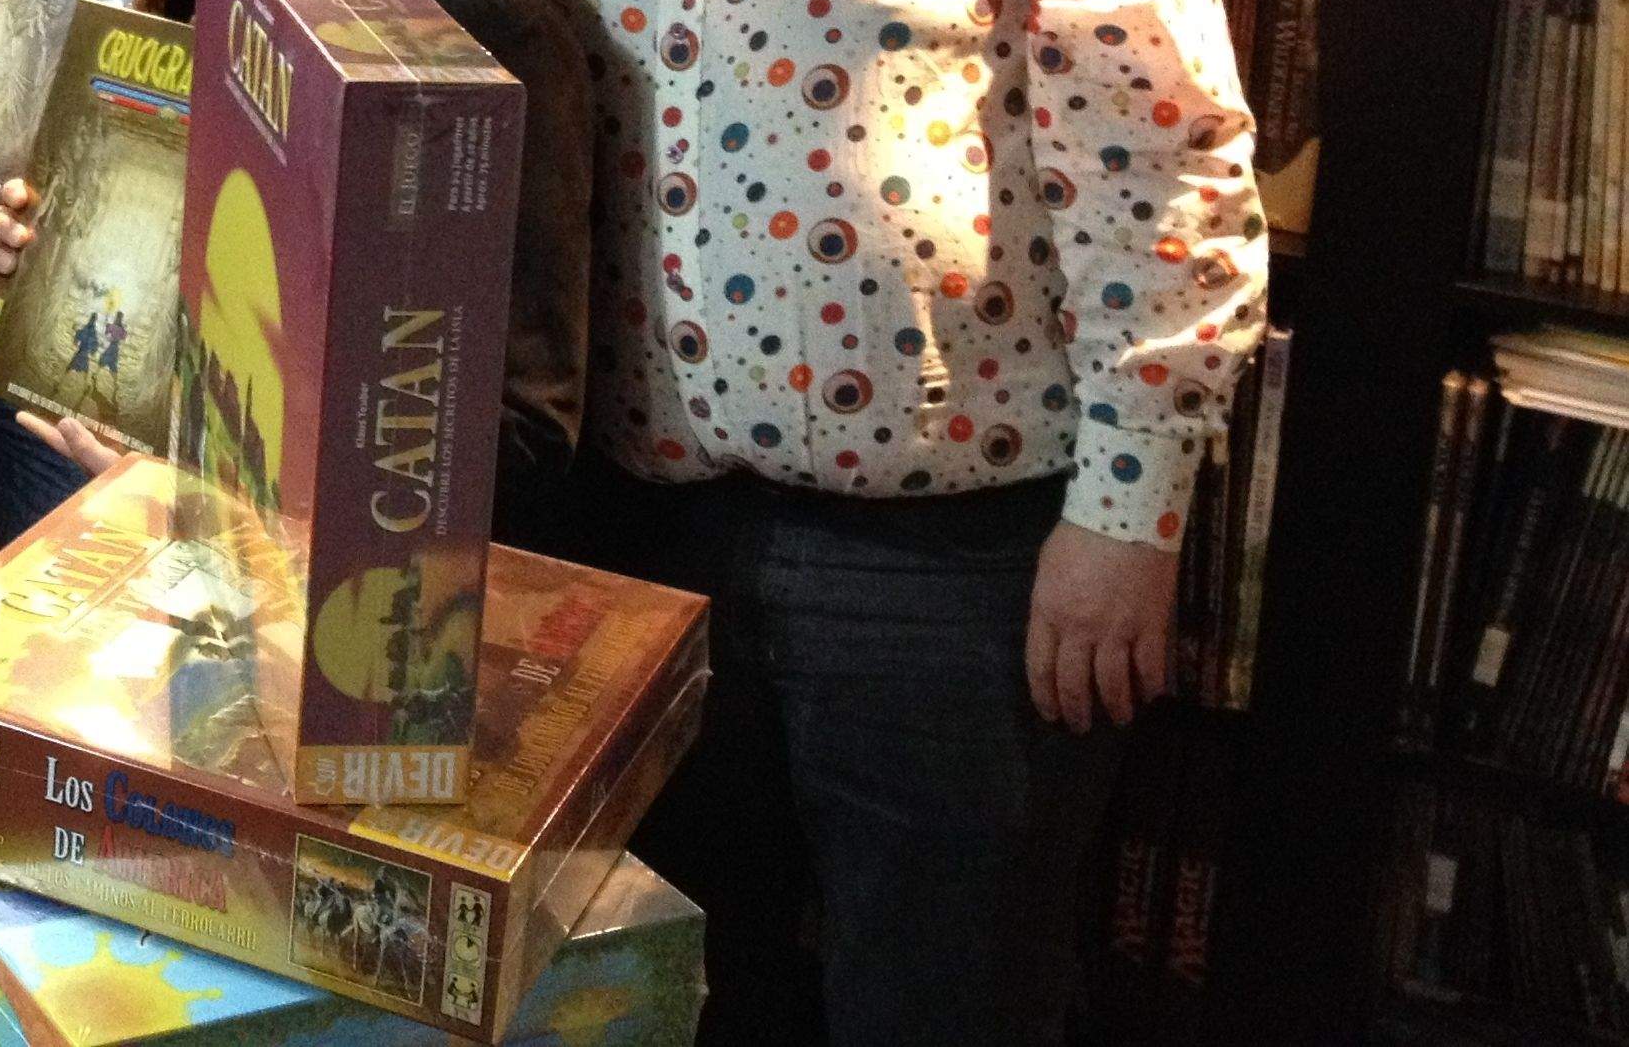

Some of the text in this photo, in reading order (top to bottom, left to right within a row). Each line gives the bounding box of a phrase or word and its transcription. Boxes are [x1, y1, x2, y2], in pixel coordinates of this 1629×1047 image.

[97, 29, 193, 93] CRUCIGRA
[371, 305, 445, 533] CATAN
[44, 755, 94, 813] LOS
[342, 752, 457, 800] DEVIR
[53, 825, 85, 866] DE
[399, 821, 519, 872] DEVIR
